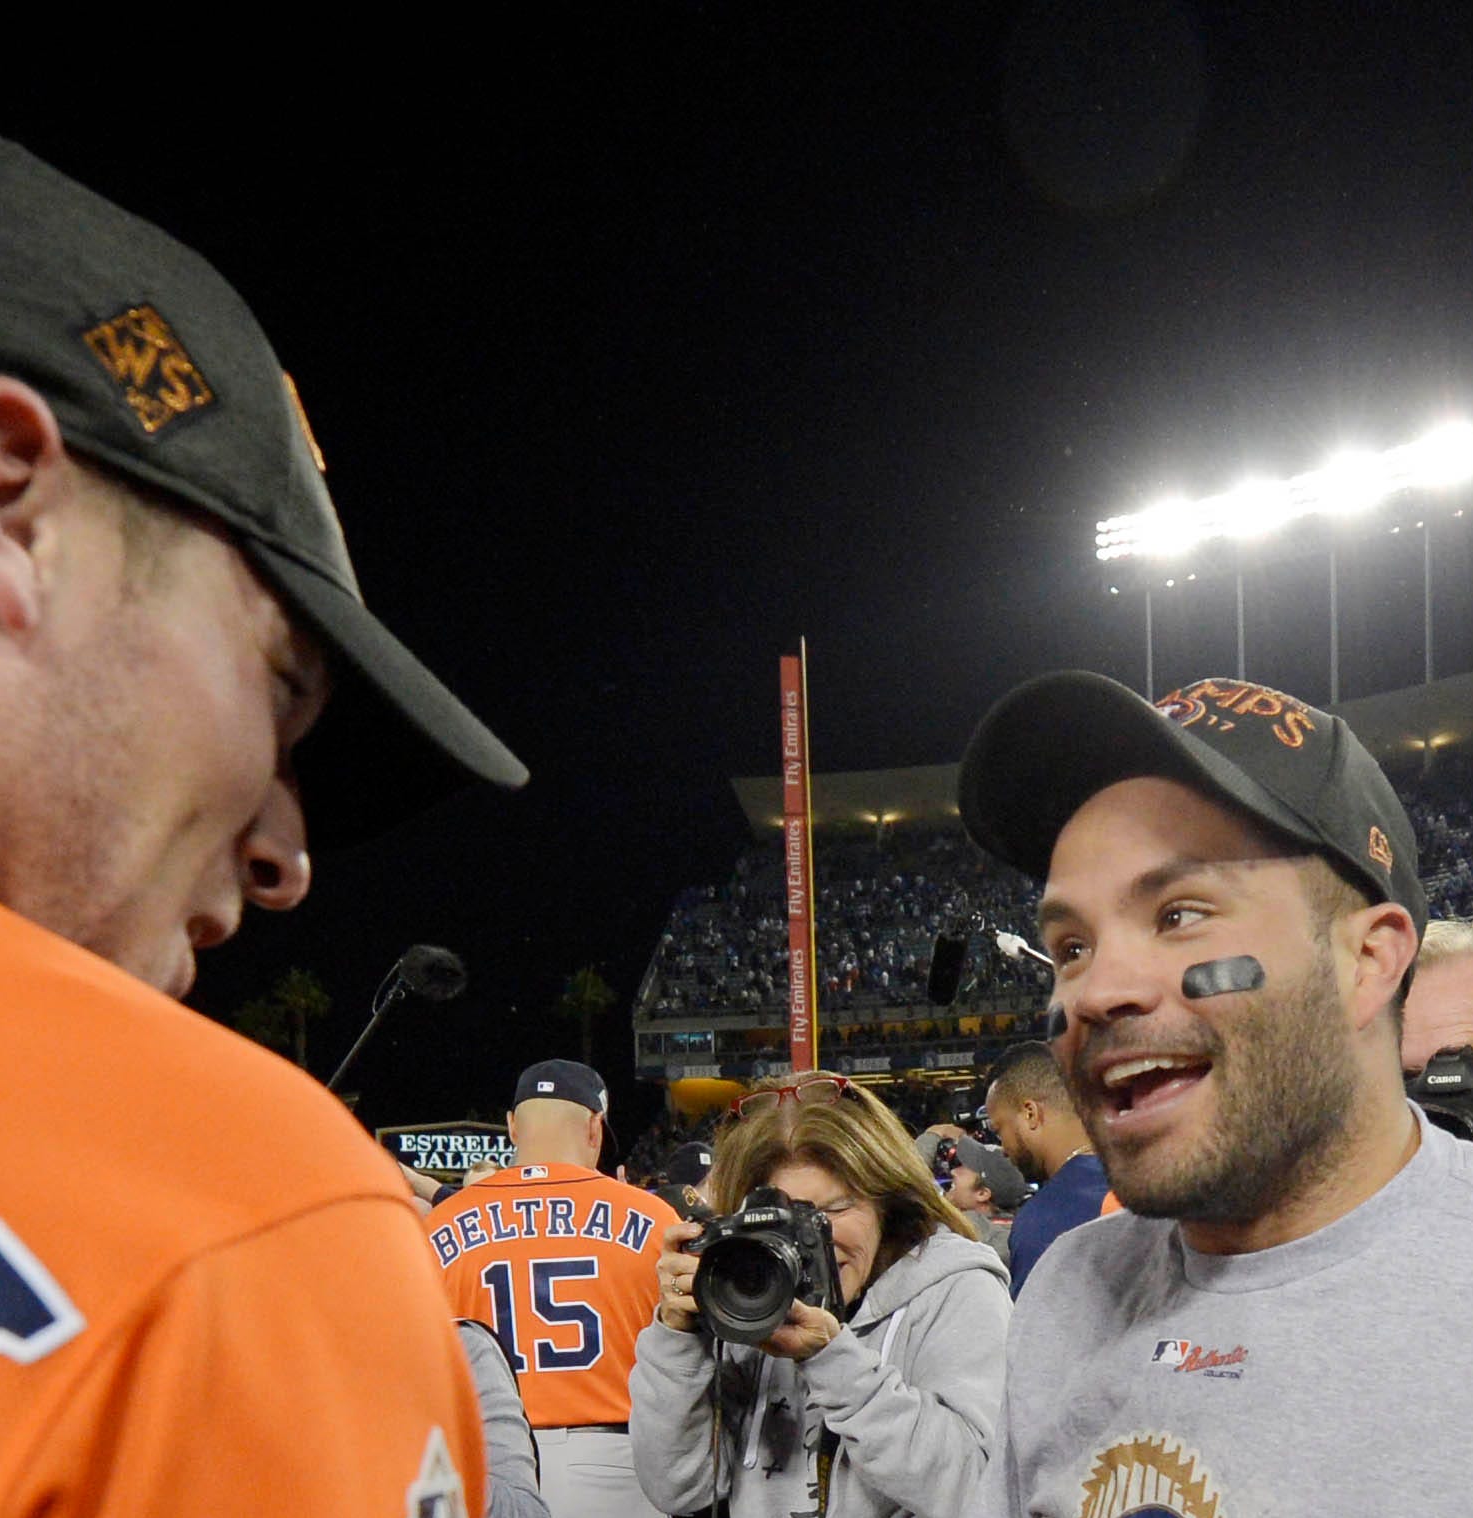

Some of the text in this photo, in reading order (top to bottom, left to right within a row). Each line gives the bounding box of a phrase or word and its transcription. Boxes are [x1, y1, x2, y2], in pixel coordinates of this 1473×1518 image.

[783, 691, 802, 785] Fly Emirates
[1155, 678, 1316, 748] MPS
[788, 819, 804, 915] Fly Emirates
[791, 949, 809, 1043] Fly Emirates
[1427, 1073, 1462, 1085] Canon
[399, 1134, 517, 1152] ESTRELL
[429, 1197, 655, 1269] BELTRAN
[744, 1213, 774, 1223] Nikon
[480, 1256, 604, 1373] 15
